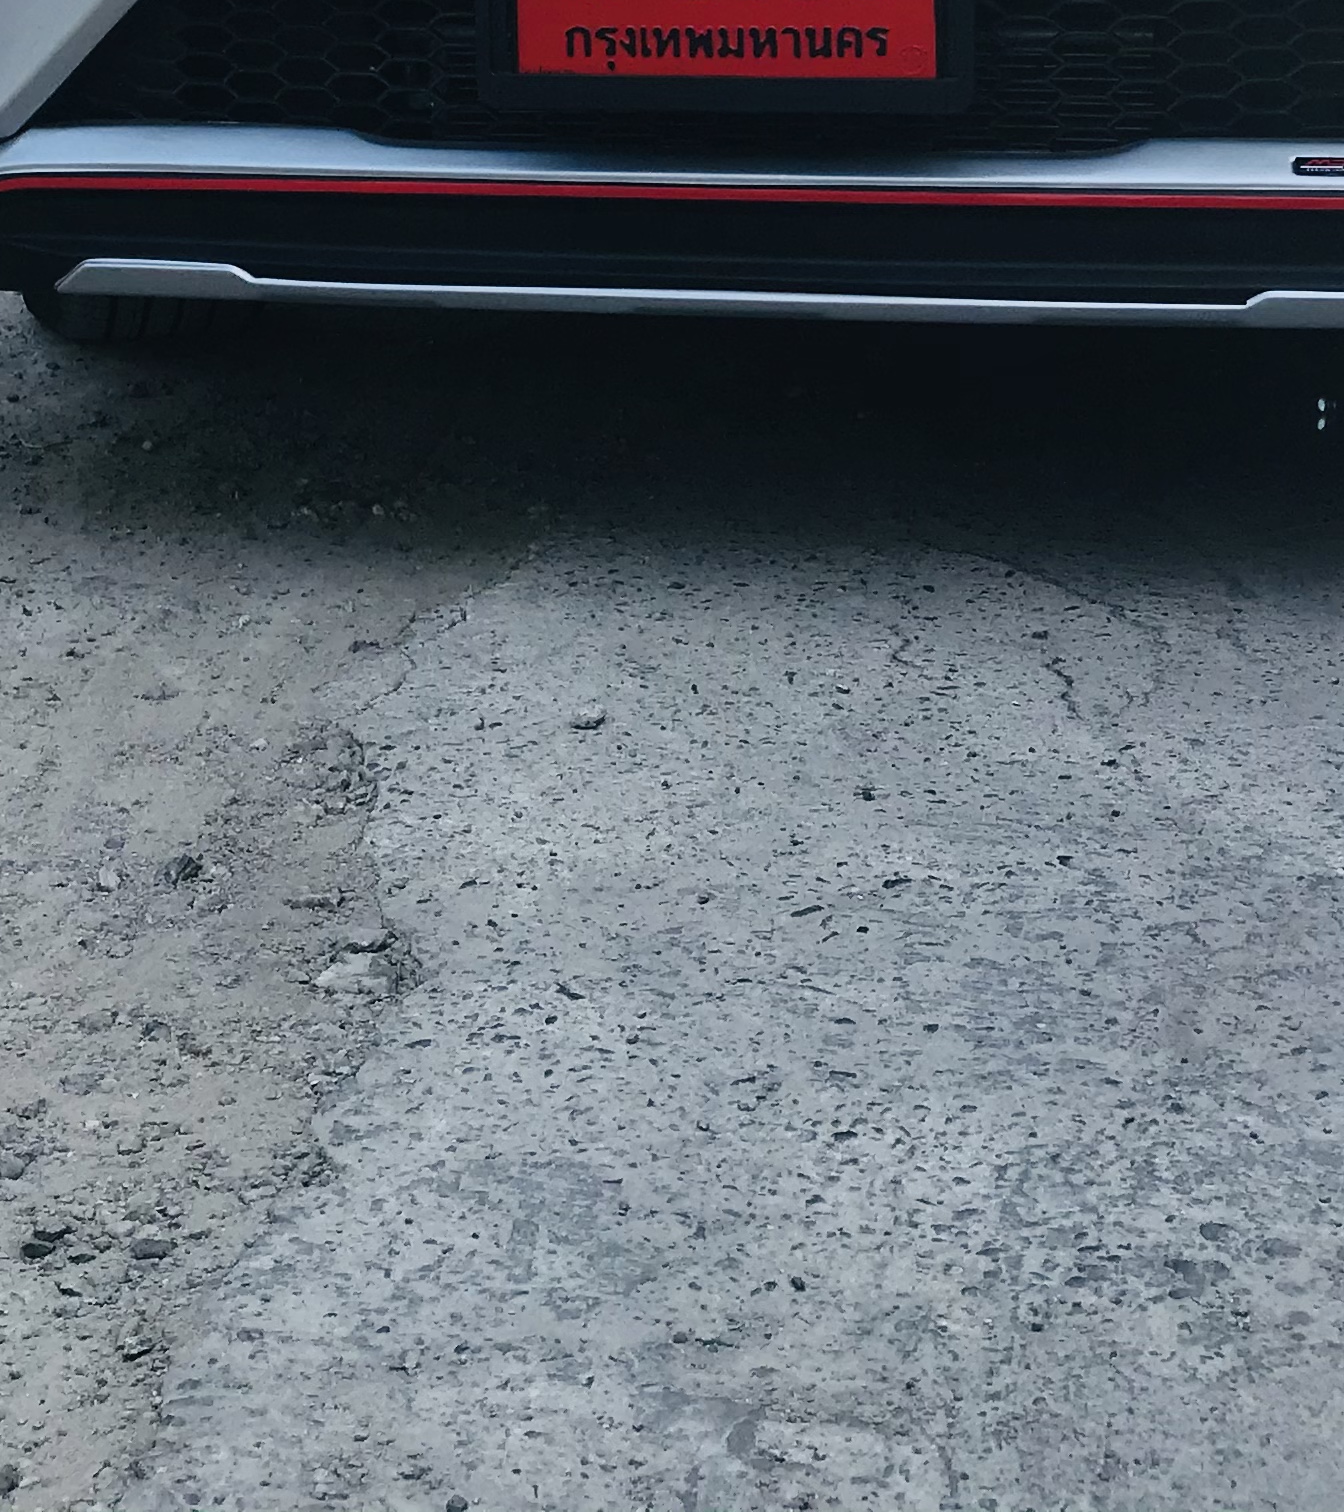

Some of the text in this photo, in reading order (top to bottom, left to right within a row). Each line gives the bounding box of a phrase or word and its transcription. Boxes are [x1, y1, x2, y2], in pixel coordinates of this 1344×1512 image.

[564, 26, 891, 71] กรุงเทพมหานคร
